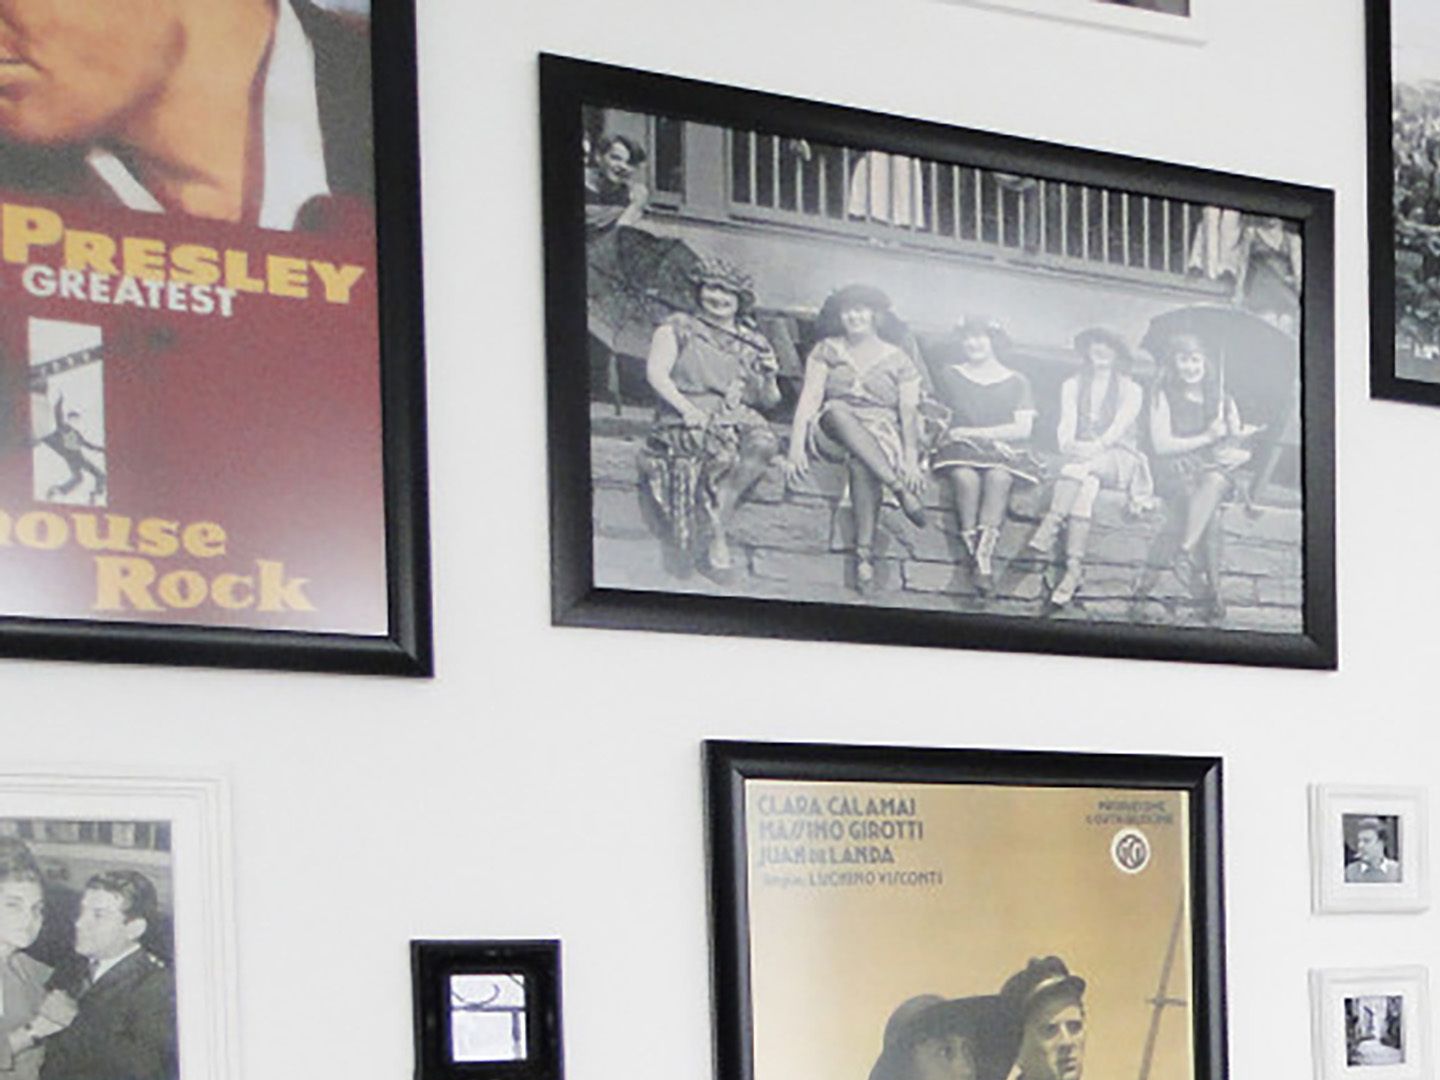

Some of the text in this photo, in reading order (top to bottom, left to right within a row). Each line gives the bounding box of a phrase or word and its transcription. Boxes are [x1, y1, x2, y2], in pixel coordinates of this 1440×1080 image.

[3, 204, 364, 304] PRESLEY
[22, 263, 237, 317] GREATEST
[0, 510, 227, 557] ouse
[94, 555, 315, 612] Rock
[829, 846, 895, 865] LANDA
[849, 821, 923, 841] GIROTTI
